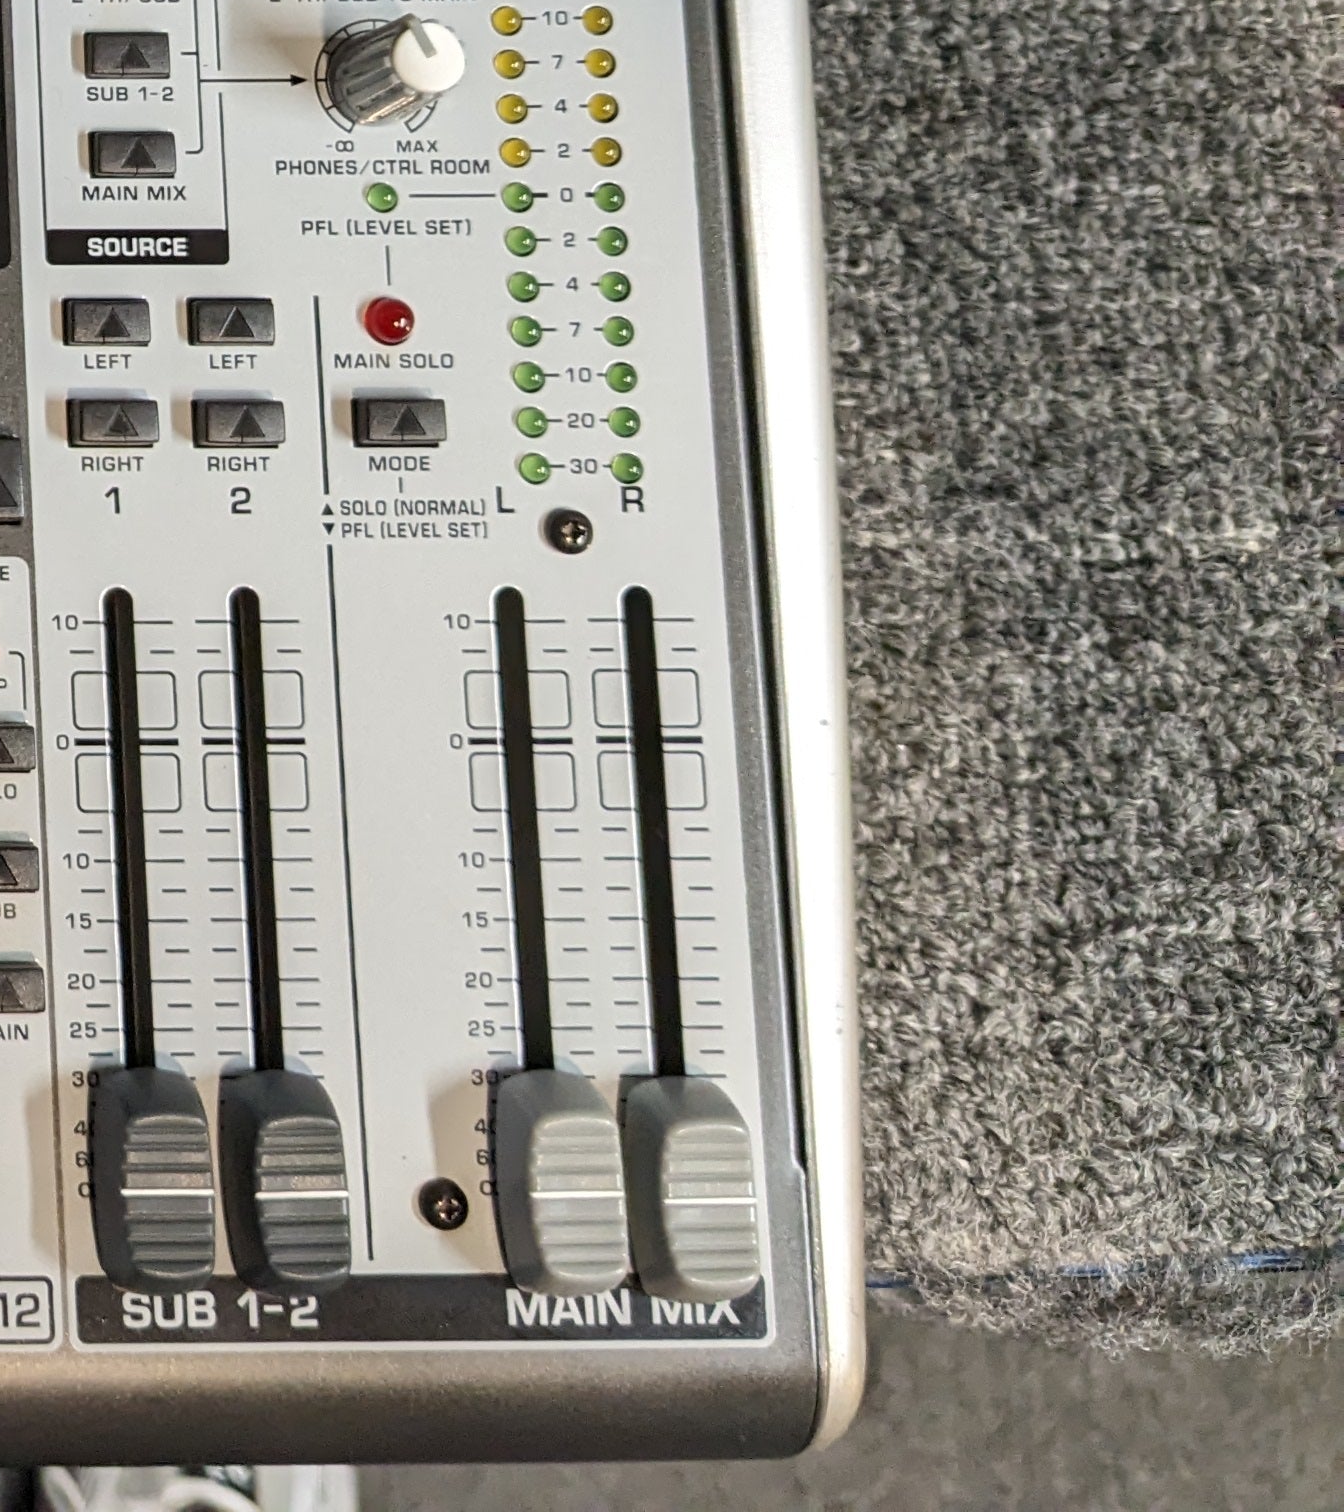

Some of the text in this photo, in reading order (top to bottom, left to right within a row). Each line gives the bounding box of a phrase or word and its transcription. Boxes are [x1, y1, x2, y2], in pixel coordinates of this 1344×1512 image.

[86, 86, 174, 102] SUB 1-2
[275, 159, 490, 176] PHONES/CTRL ROOM
[82, 185, 187, 201] MAIN MIX
[301, 218, 471, 237] PFL (LEVEL SET)
[87, 237, 188, 257] SOURCE
[334, 353, 454, 369] MAIN SOLO
[81, 455, 144, 472] RIGHT
[368, 455, 431, 472] MODE
[339, 498, 486, 517] SOLO (NORMAL)
[120, 1293, 321, 1329] SUB 1-2
[506, 1290, 741, 1328] MAIN MIX
